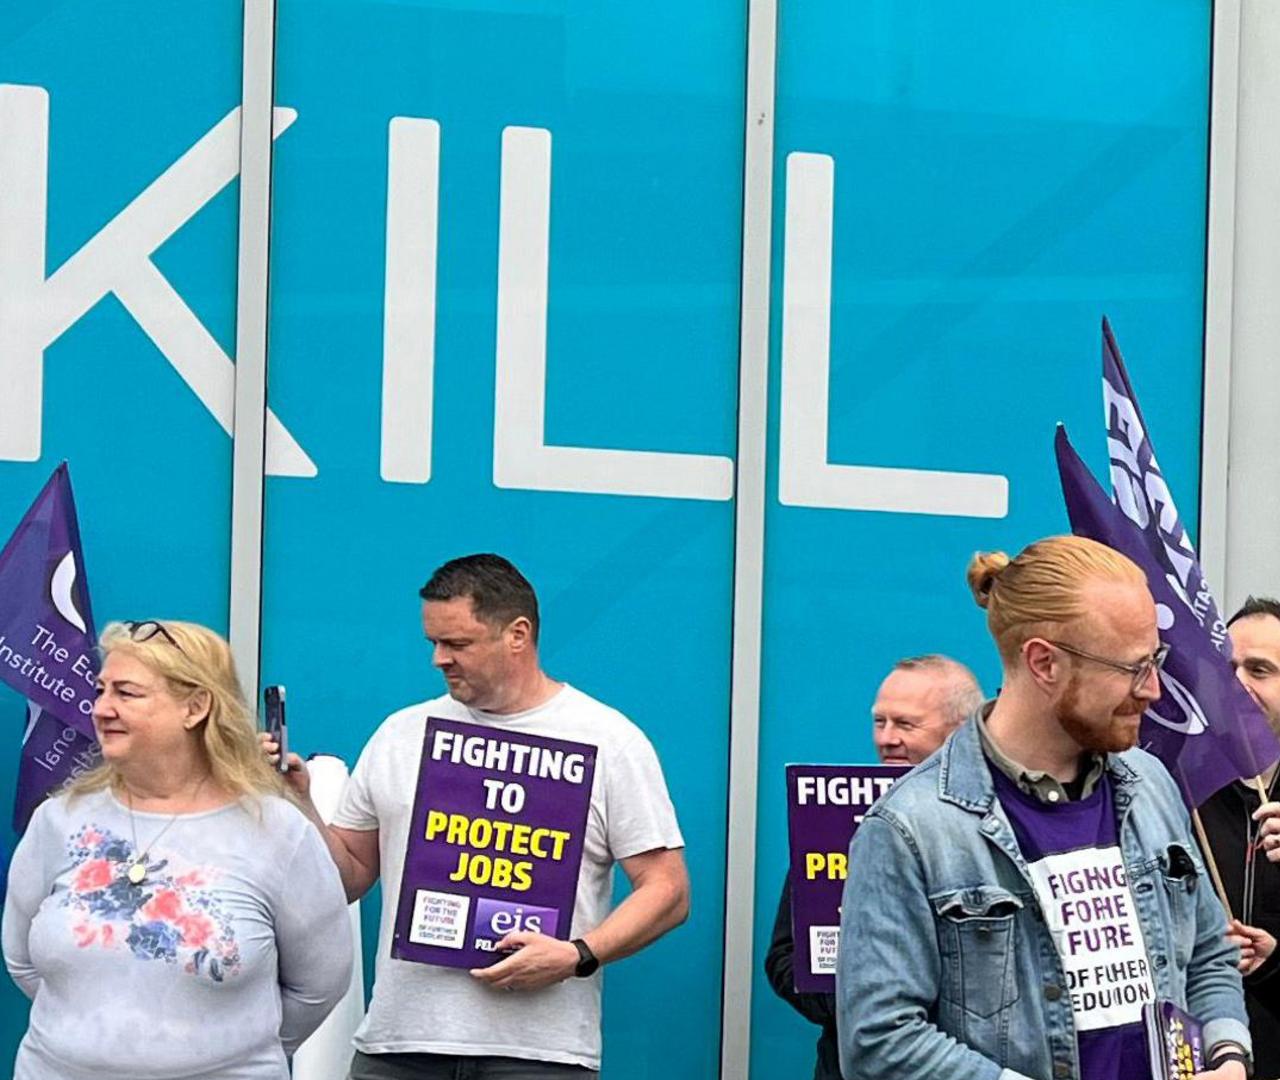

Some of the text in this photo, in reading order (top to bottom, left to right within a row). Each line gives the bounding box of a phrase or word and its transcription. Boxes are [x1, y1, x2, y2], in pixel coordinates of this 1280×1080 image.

[31, 624, 70, 663] The
[431, 730, 585, 784] FIGHTING
[483, 779, 526, 813] TO
[797, 777, 899, 805] FIGHT
[424, 810, 570, 860] PROTECT
[449, 852, 534, 892] JOBS
[1048, 865, 1127, 899] FIGHNG
[491, 907, 542, 935] eis
